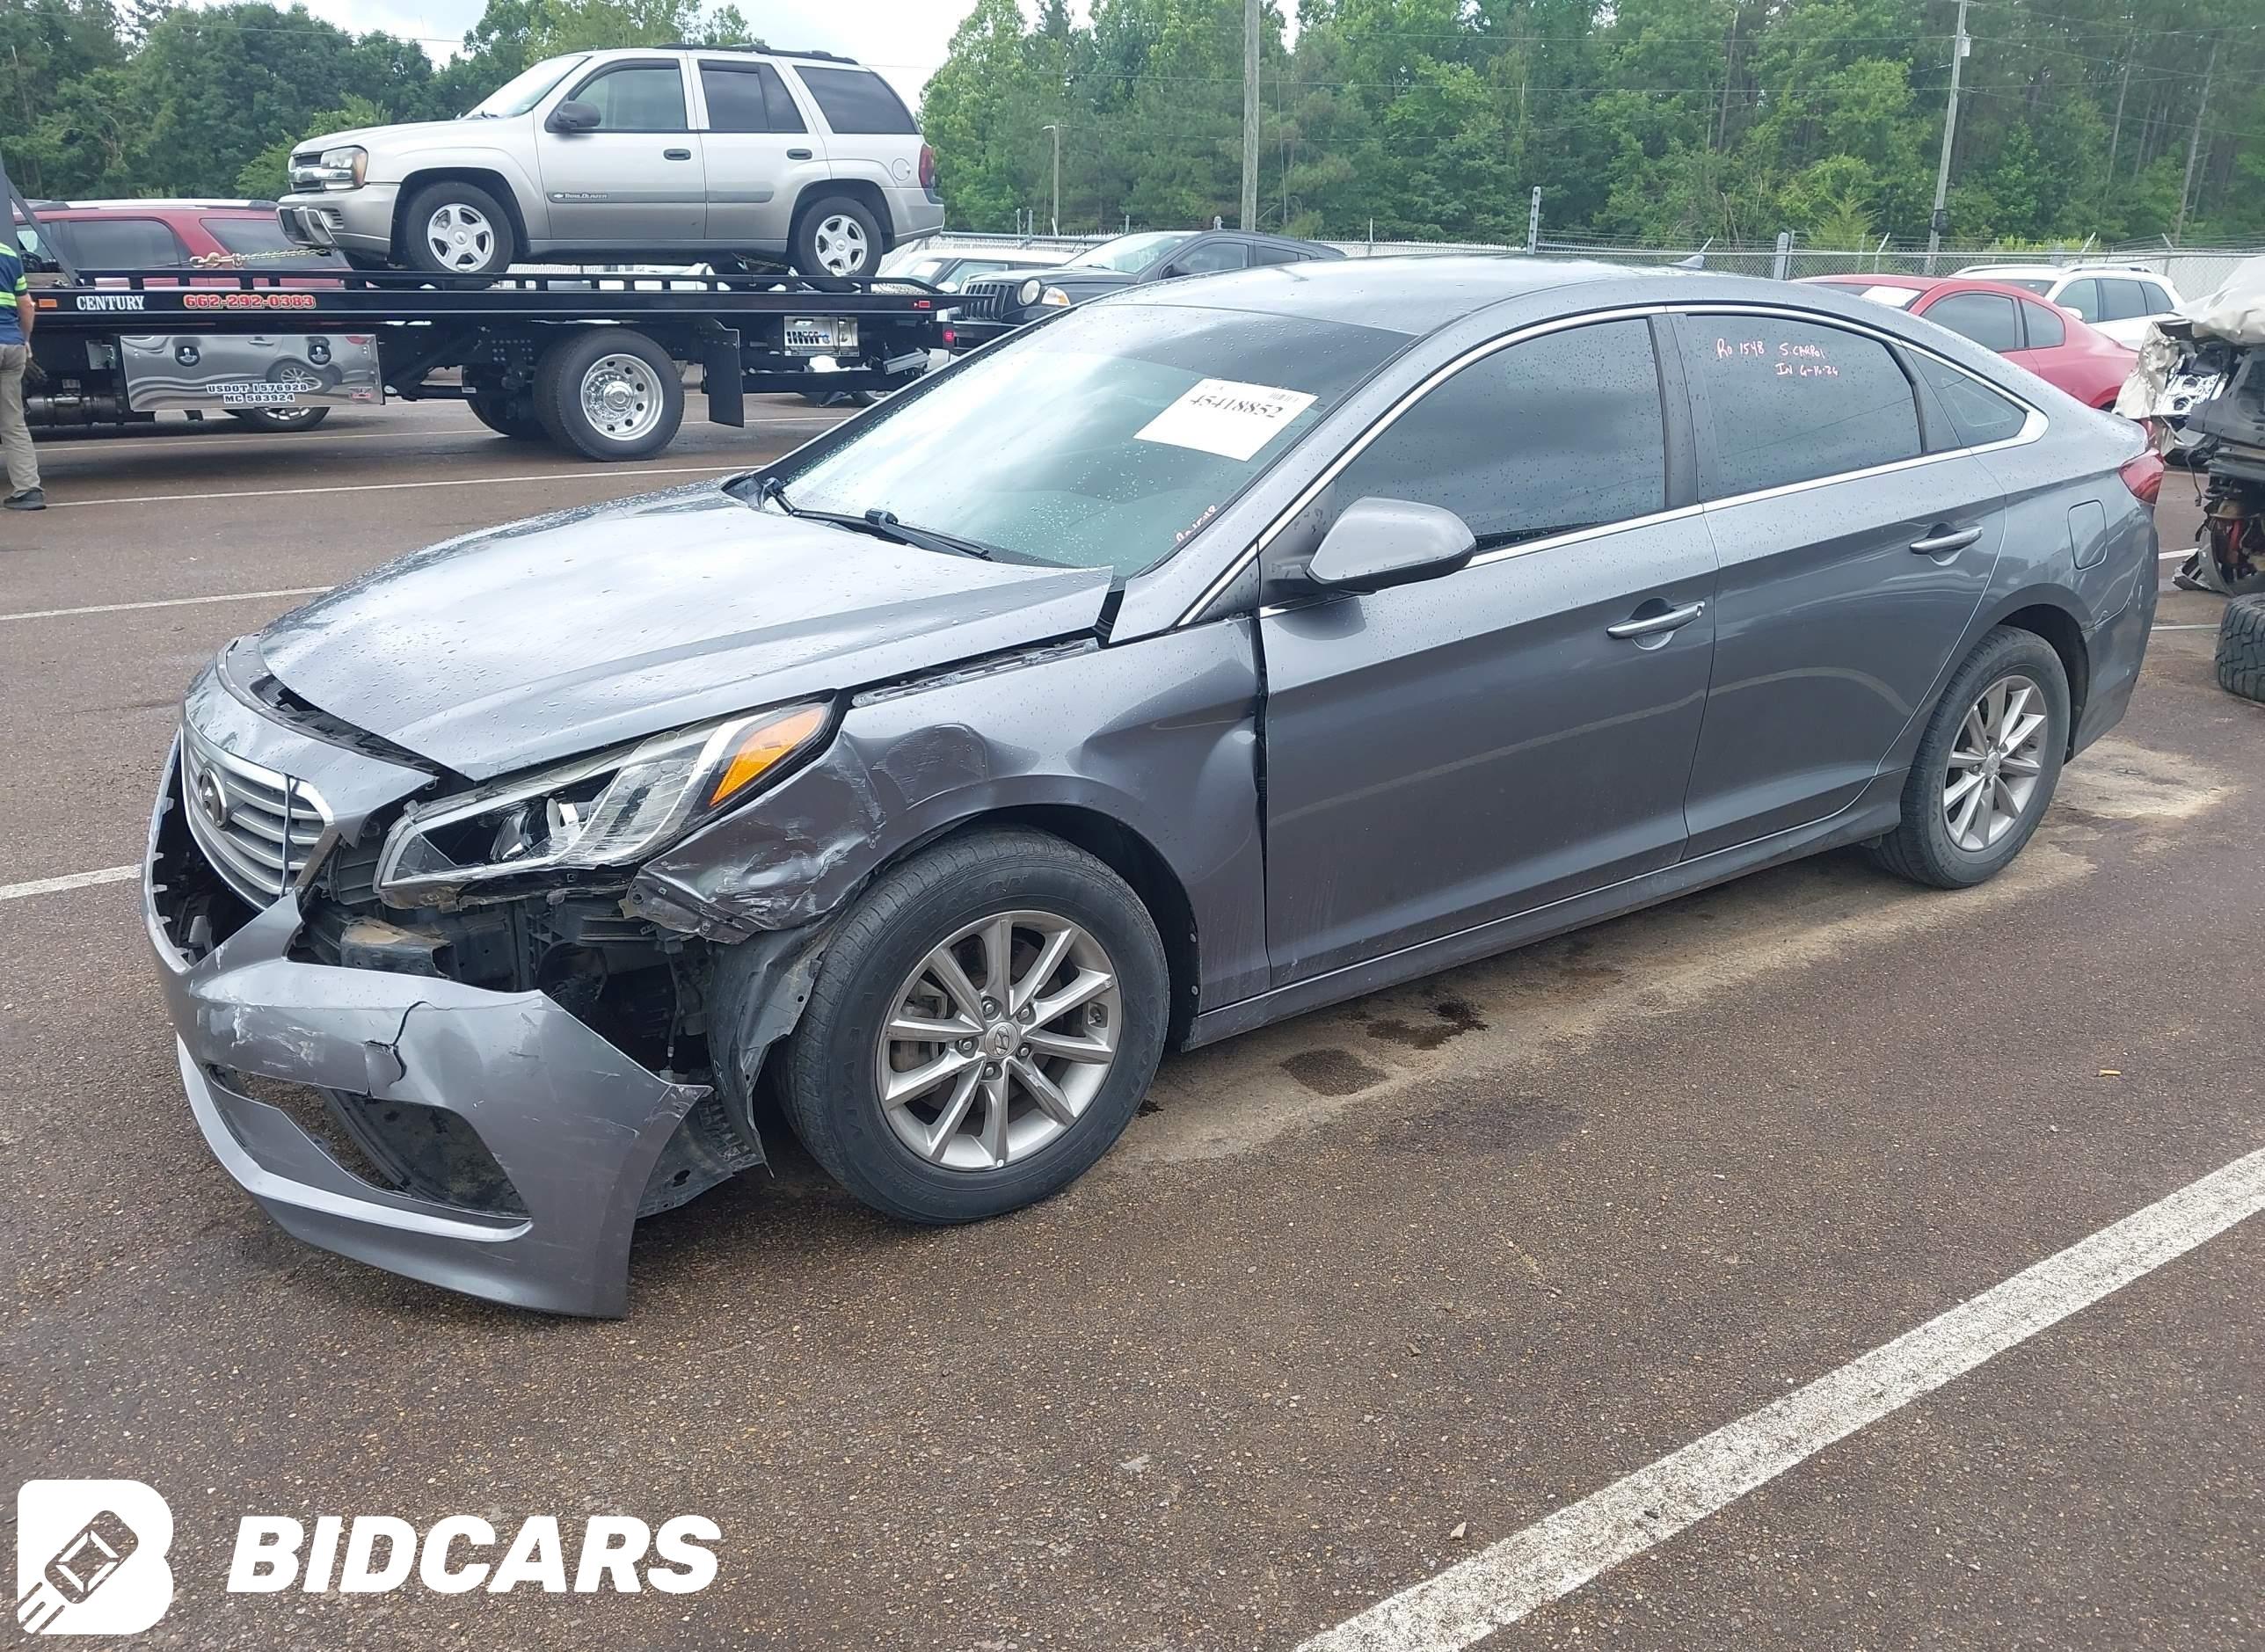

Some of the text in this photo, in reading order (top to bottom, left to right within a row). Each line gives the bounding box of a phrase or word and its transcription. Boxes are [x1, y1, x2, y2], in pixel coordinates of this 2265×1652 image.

[76, 295, 145, 310] CENTURY
[183, 294, 317, 309] 662-292-0383
[207, 382, 310, 394] USDOT 1576928
[224, 393, 295, 404] MC 583924
[1190, 394, 1284, 418] 45418852
